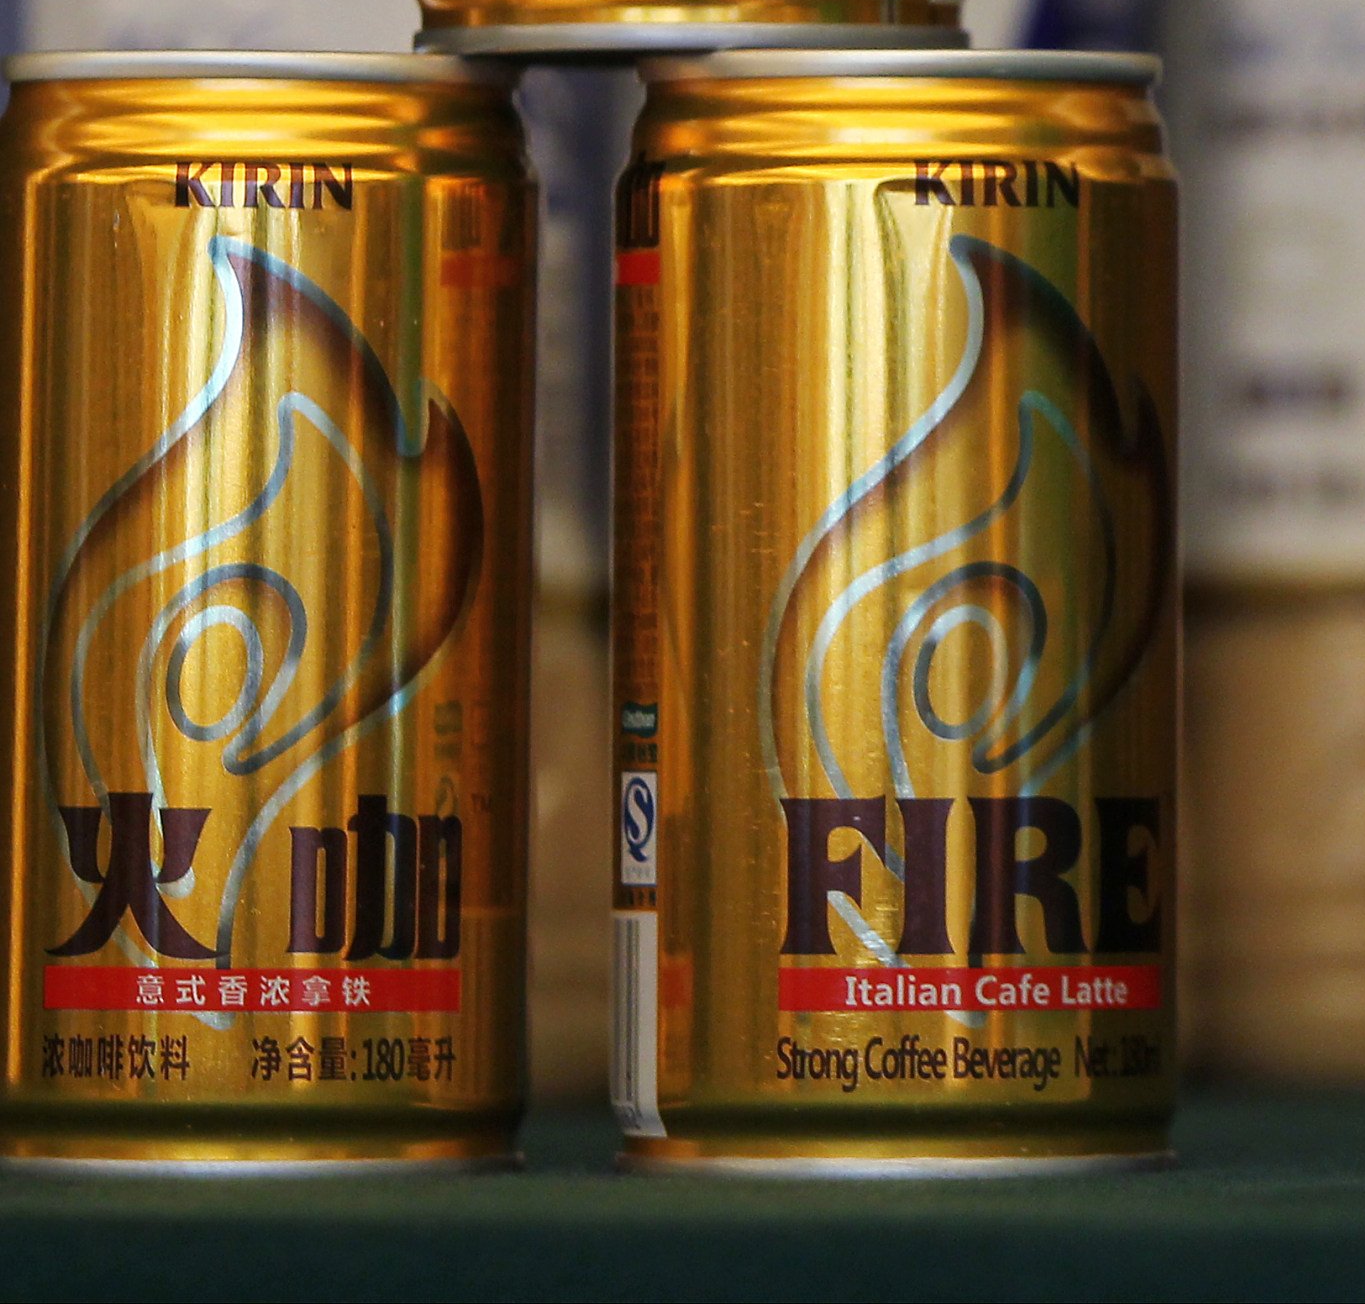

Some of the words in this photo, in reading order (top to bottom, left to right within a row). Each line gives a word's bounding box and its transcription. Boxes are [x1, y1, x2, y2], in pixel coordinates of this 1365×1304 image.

[175, 159, 354, 212] KIRIN
[912, 158, 1081, 208] KIRIN
[44, 791, 463, 963] 火咖
[780, 795, 1162, 954] FIRE
[135, 974, 372, 1007] 意式香浓拿铁
[845, 974, 962, 1006] Italian
[975, 975, 1050, 1006] Cafe
[1060, 975, 1128, 1006] Latte
[42, 1034, 190, 1080] 浓咖啡饮料
[251, 1035, 456, 1081] 净含量:180毫升
[777, 1035, 859, 1093] Strong
[865, 1035, 947, 1081] Coffee
[954, 1035, 1061, 1092] Beverage
